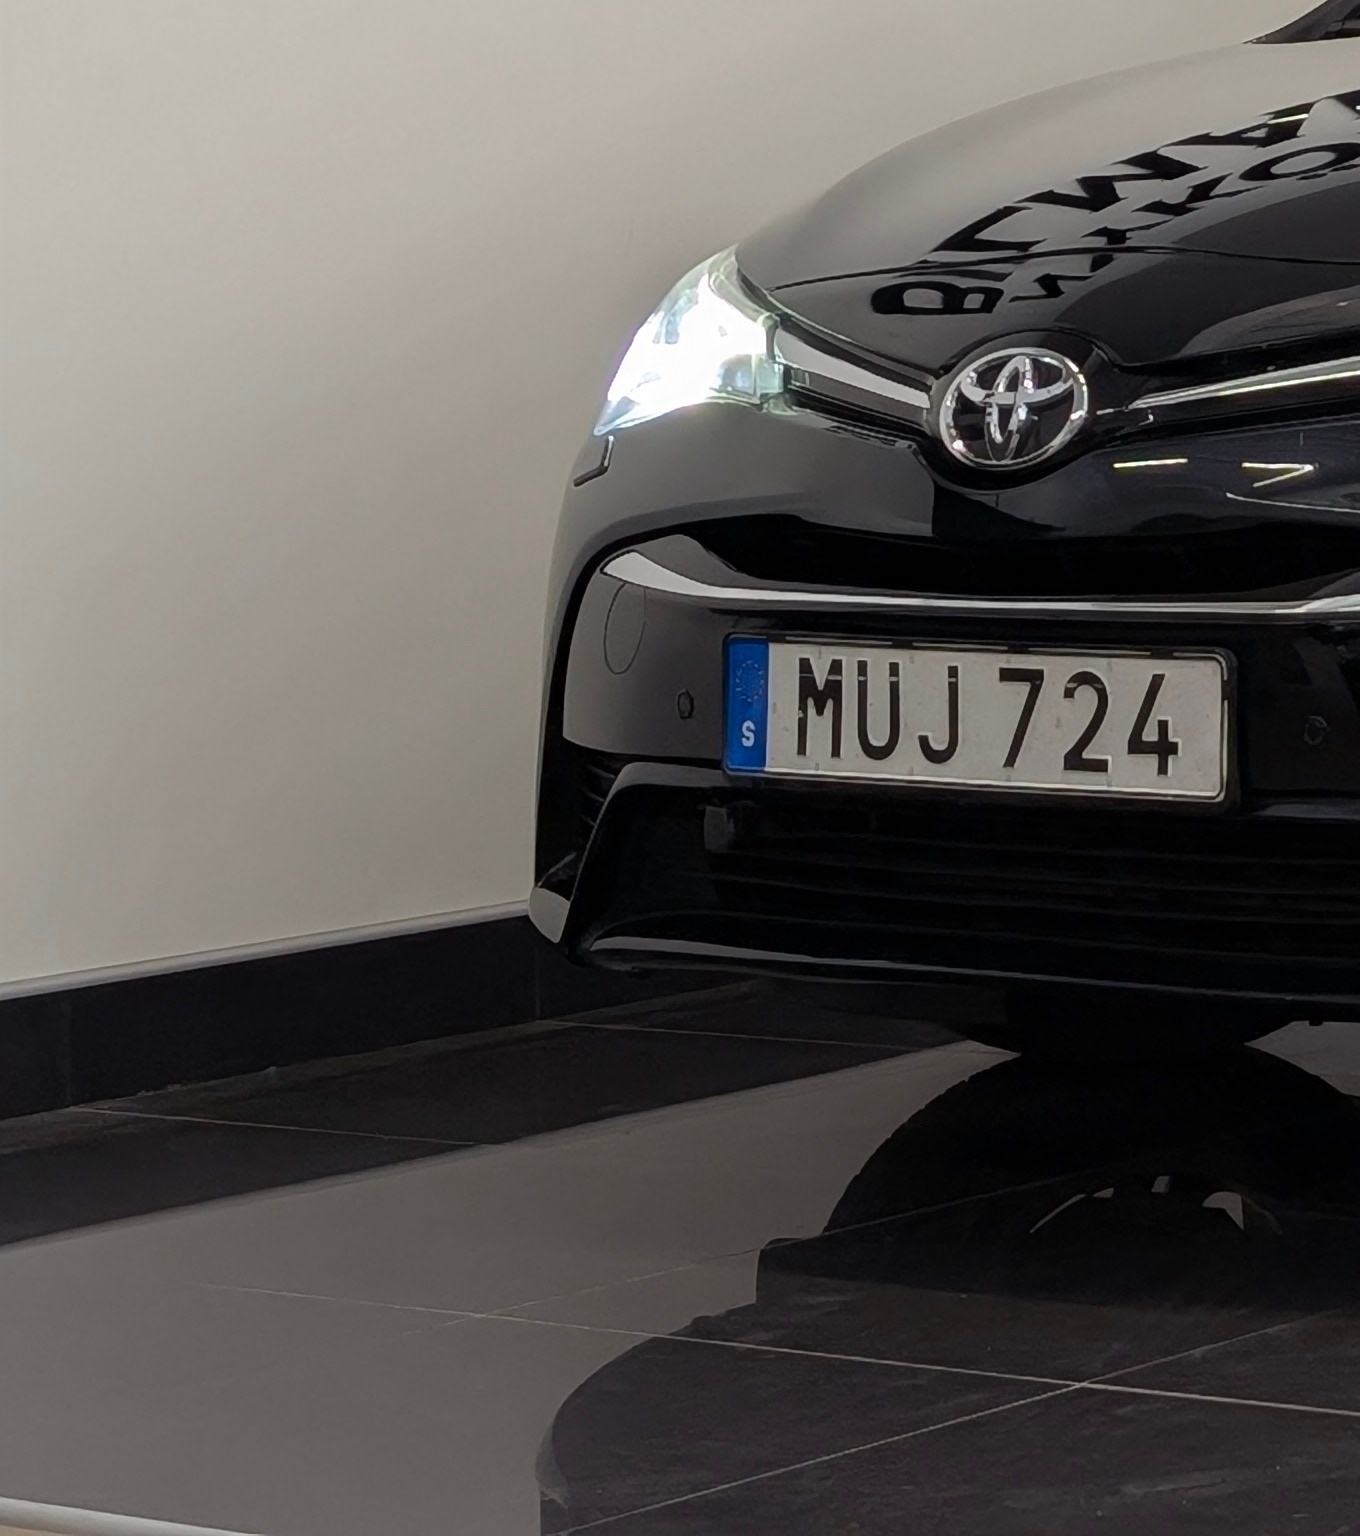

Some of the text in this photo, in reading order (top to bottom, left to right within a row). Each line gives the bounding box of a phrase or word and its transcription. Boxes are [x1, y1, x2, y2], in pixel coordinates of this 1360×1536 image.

[740, 718, 756, 749] S
[796, 656, 1181, 777] MUJ 724
